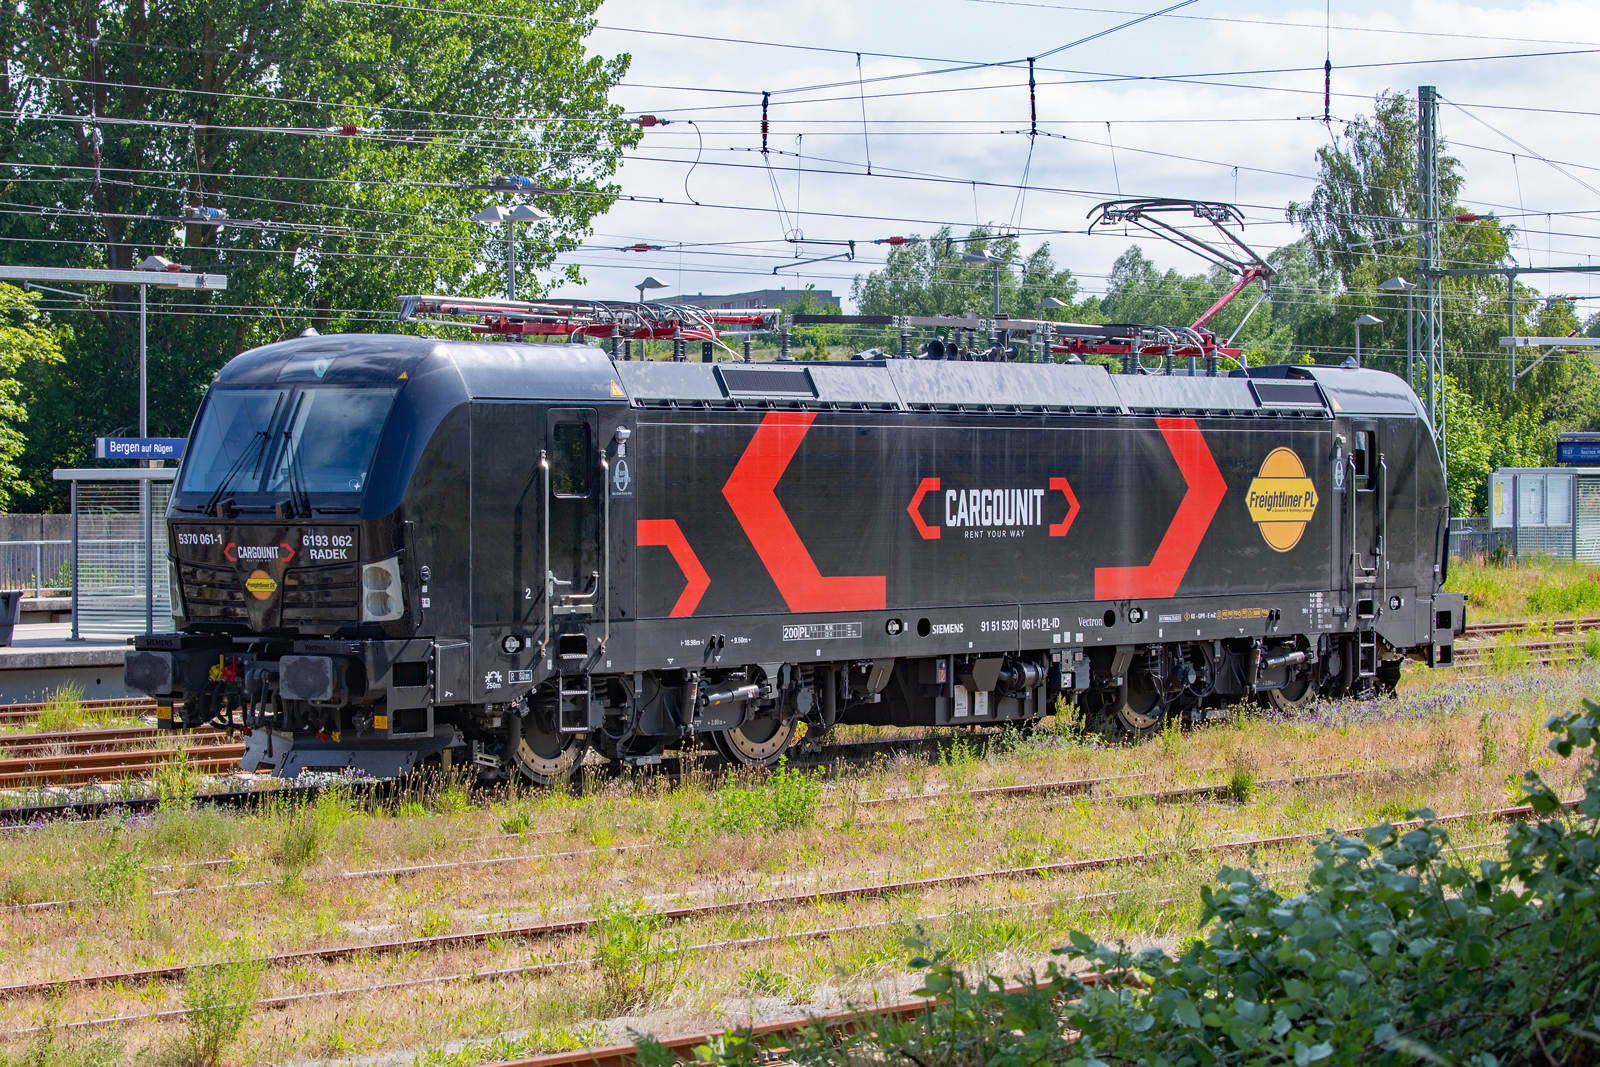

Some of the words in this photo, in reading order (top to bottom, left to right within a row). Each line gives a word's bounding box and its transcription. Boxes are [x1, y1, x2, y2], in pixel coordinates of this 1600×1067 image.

[110, 441, 140, 455] Bergen
[141, 444, 152, 453] auf
[153, 444, 173, 455] Rügen
[1249, 490, 1303, 512] Freightliner
[1303, 491, 1315, 508] PL
[945, 488, 1045, 527] CARGOUNIT
[178, 533, 198, 545] 5370
[199, 533, 223, 545] 061-1
[964, 530, 984, 539] RENT
[987, 530, 1007, 538] YOUR
[1010, 529, 1025, 538] WAY
[302, 534, 329, 547] 6193
[331, 535, 353, 547] 062
[237, 546, 279, 559] CARGOUNIT
[309, 548, 348, 560] RADEK
[525, 588, 532, 599] 2
[981, 621, 990, 632] 91
[991, 621, 1000, 632] 51
[1001, 620, 1019, 631] 5370
[1022, 619, 1041, 630] 061-1
[1041, 617, 1060, 631] PL-ID
[1078, 616, 1103, 627] Vectron
[784, 627, 798, 639] 200
[799, 626, 810, 638] PL
[932, 623, 964, 634] SIEMENS
[146, 639, 173, 647] SIEMENS
[304, 643, 326, 651] Vectron
[510, 672, 515, 681] R
[486, 682, 502, 690] 250m
